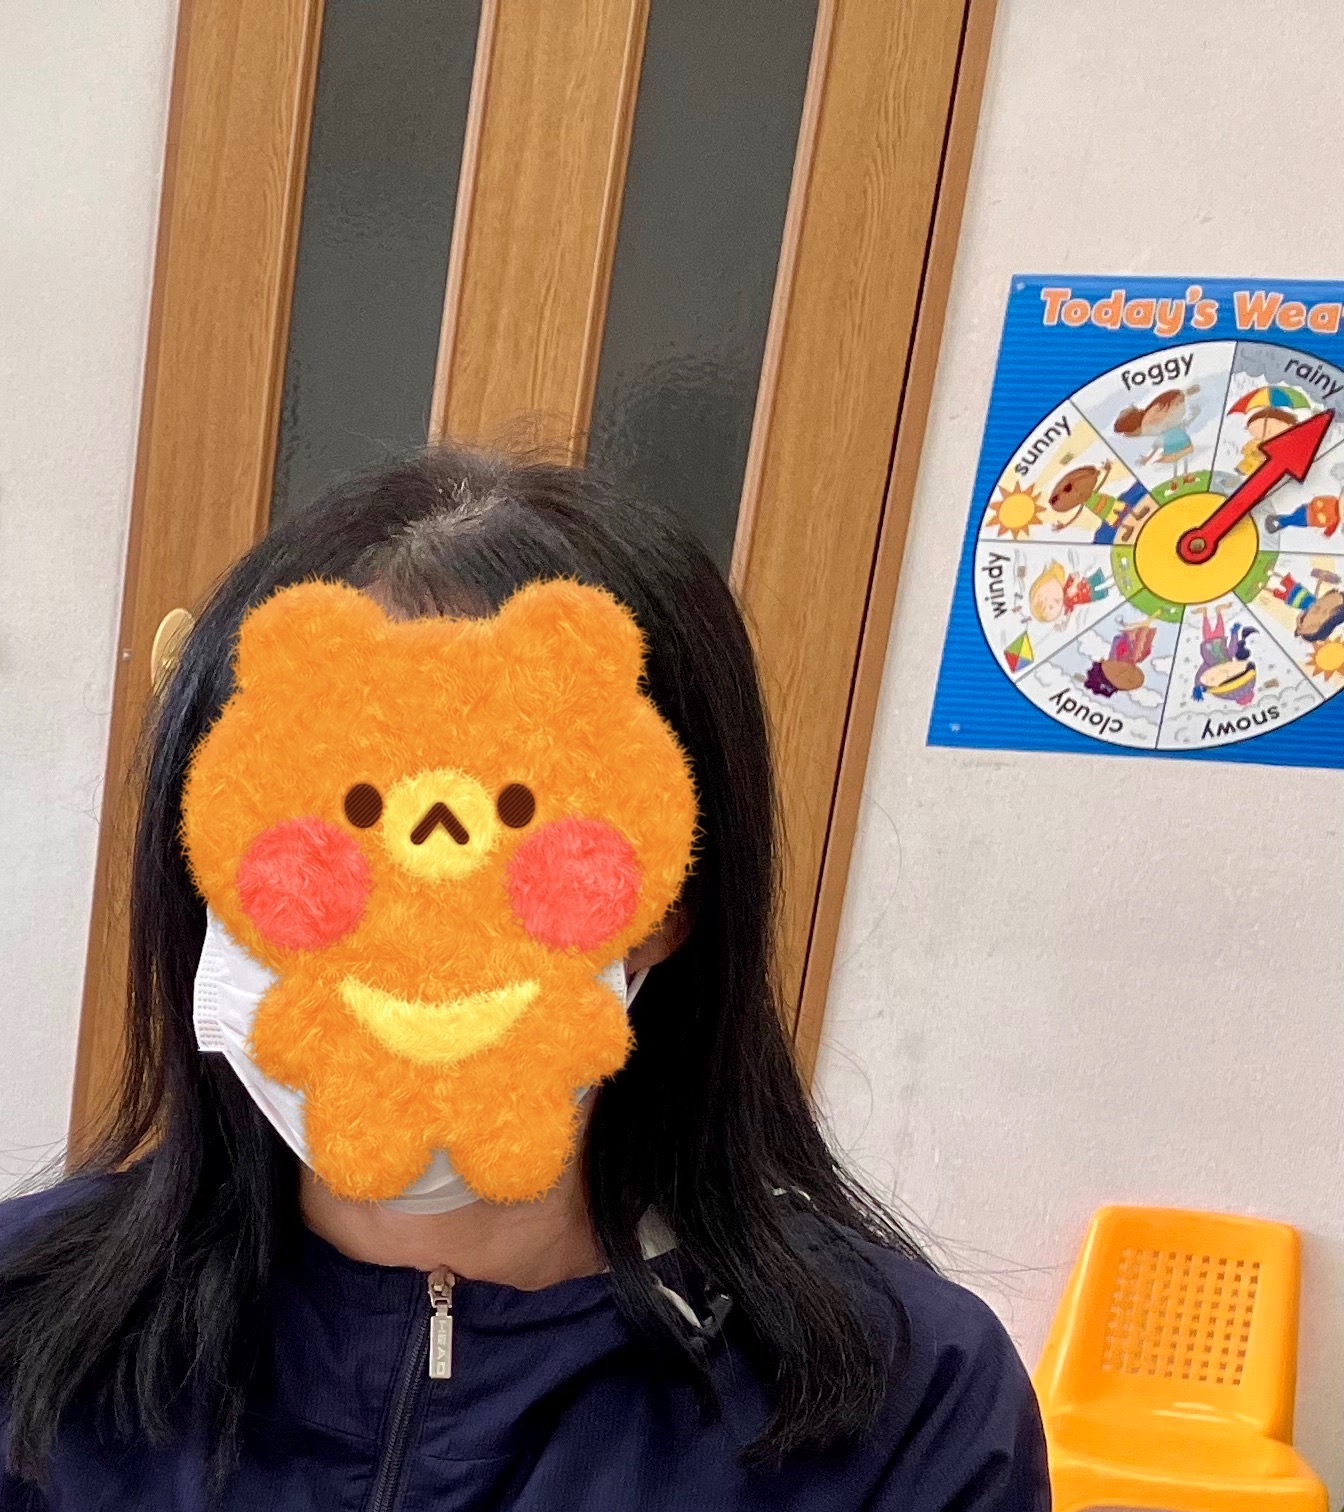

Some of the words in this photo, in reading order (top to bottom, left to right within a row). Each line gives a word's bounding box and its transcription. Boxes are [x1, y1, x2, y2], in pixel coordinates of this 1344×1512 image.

[1040, 285, 1219, 337] Today's
[1233, 291, 1344, 334] Wea
[1120, 353, 1194, 391] foggy
[1284, 358, 1344, 400] rainy
[1013, 415, 1073, 477] sunny
[981, 551, 1011, 620] windy
[1049, 688, 1124, 735] cloudy
[1200, 705, 1281, 740] snowy
